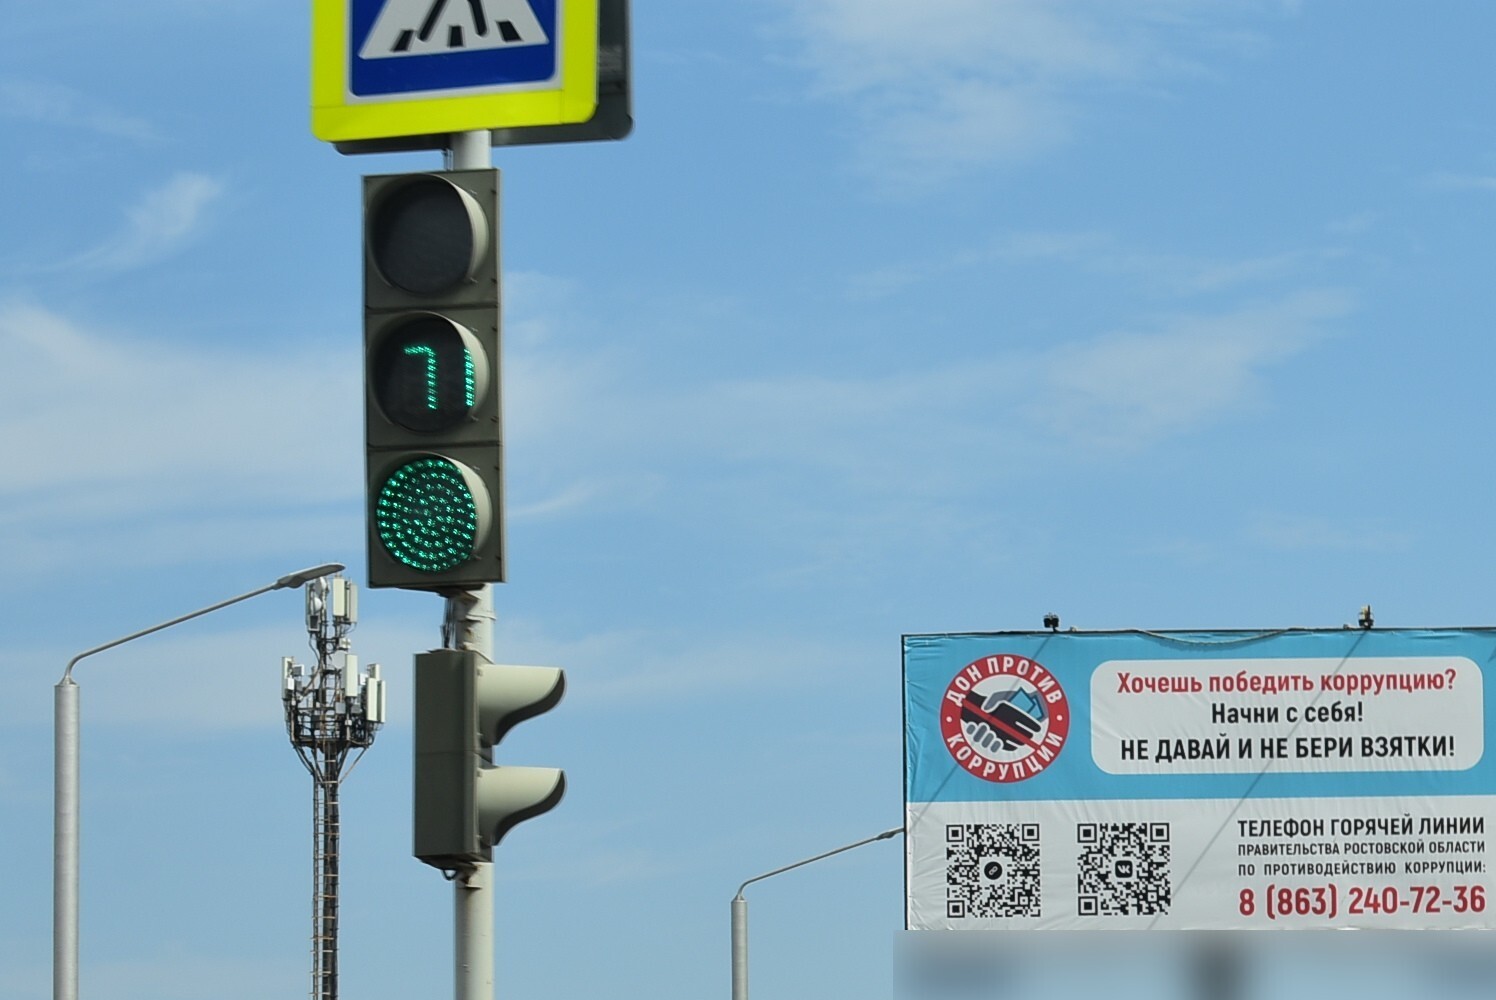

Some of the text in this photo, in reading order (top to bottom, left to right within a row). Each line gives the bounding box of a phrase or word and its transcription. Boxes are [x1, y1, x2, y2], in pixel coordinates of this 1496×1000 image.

[946, 656, 1063, 707] ДОН ПРОТИВ
[1117, 669, 1456, 695] Хочешь победить коррупцию?
[1211, 701, 1364, 724] Начни с себя!
[947, 732, 1063, 780] КОРРУПЦИИ
[1120, 733, 1455, 763] НЕ ДАВАЙ И НЕ БЕРИ ВЗЯТКИ!
[1238, 814, 1485, 838] ТЕЛЕФОН ГОРЯЧЕЙ ЛИНИИ
[1238, 839, 1485, 856] ПРАВИТЕЛЬСТВА РОСТОВСКОЙ ОБЛАСТИ
[1238, 860, 1486, 876] ПО ПРОТИВОДЕЙСТВИЮ КОРРУПЦИИ:
[1239, 883, 1486, 920] 8 (863) 240-72-36
